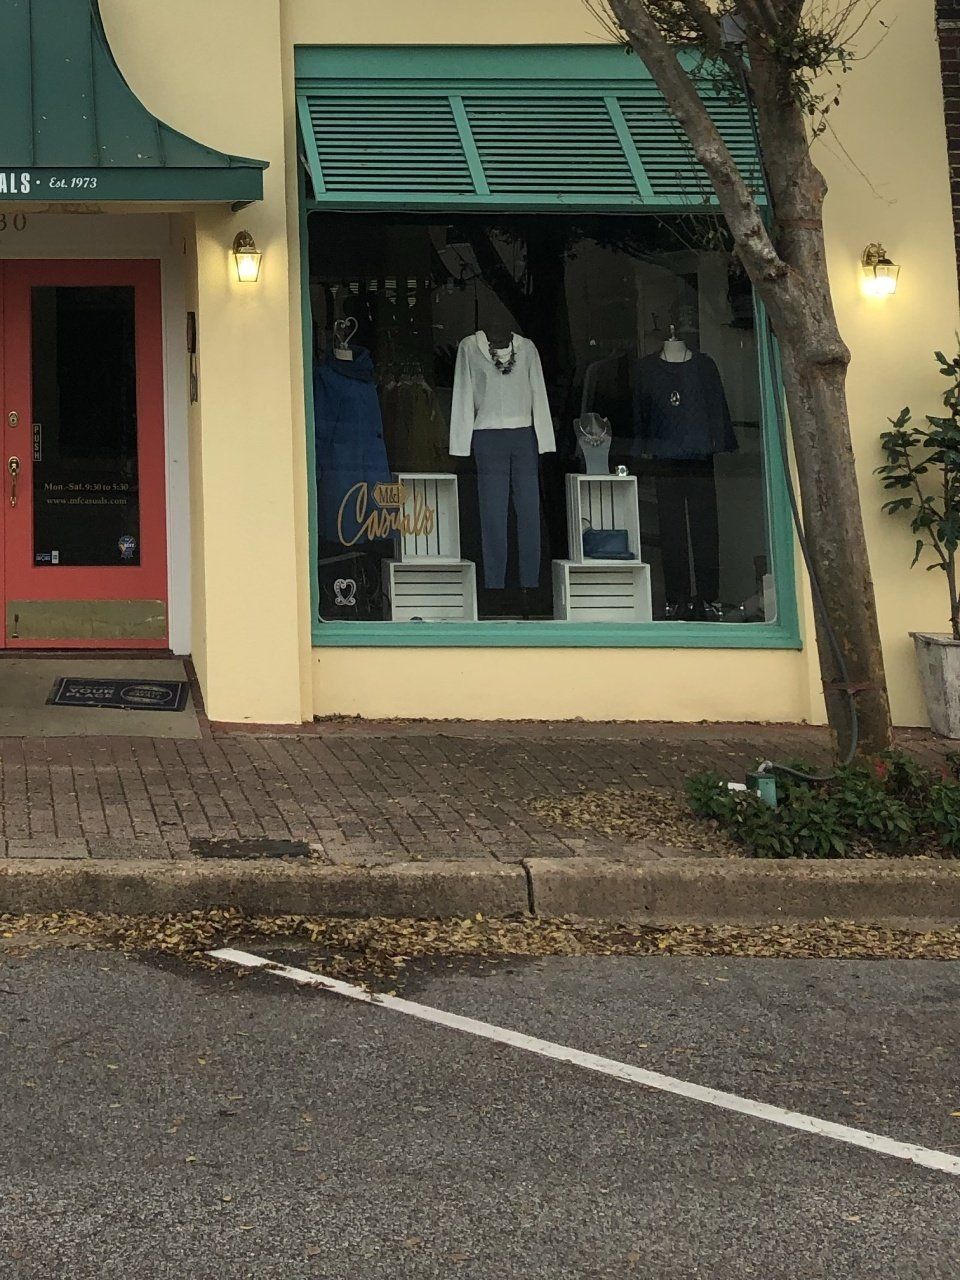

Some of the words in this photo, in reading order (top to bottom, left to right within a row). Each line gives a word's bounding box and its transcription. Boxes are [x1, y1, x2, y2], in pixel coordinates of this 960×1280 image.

[48, 177, 68, 188] Est.
[70, 176, 98, 189] 1973
[103, 483, 111, 491] to
[338, 482, 434, 547] Casuals
